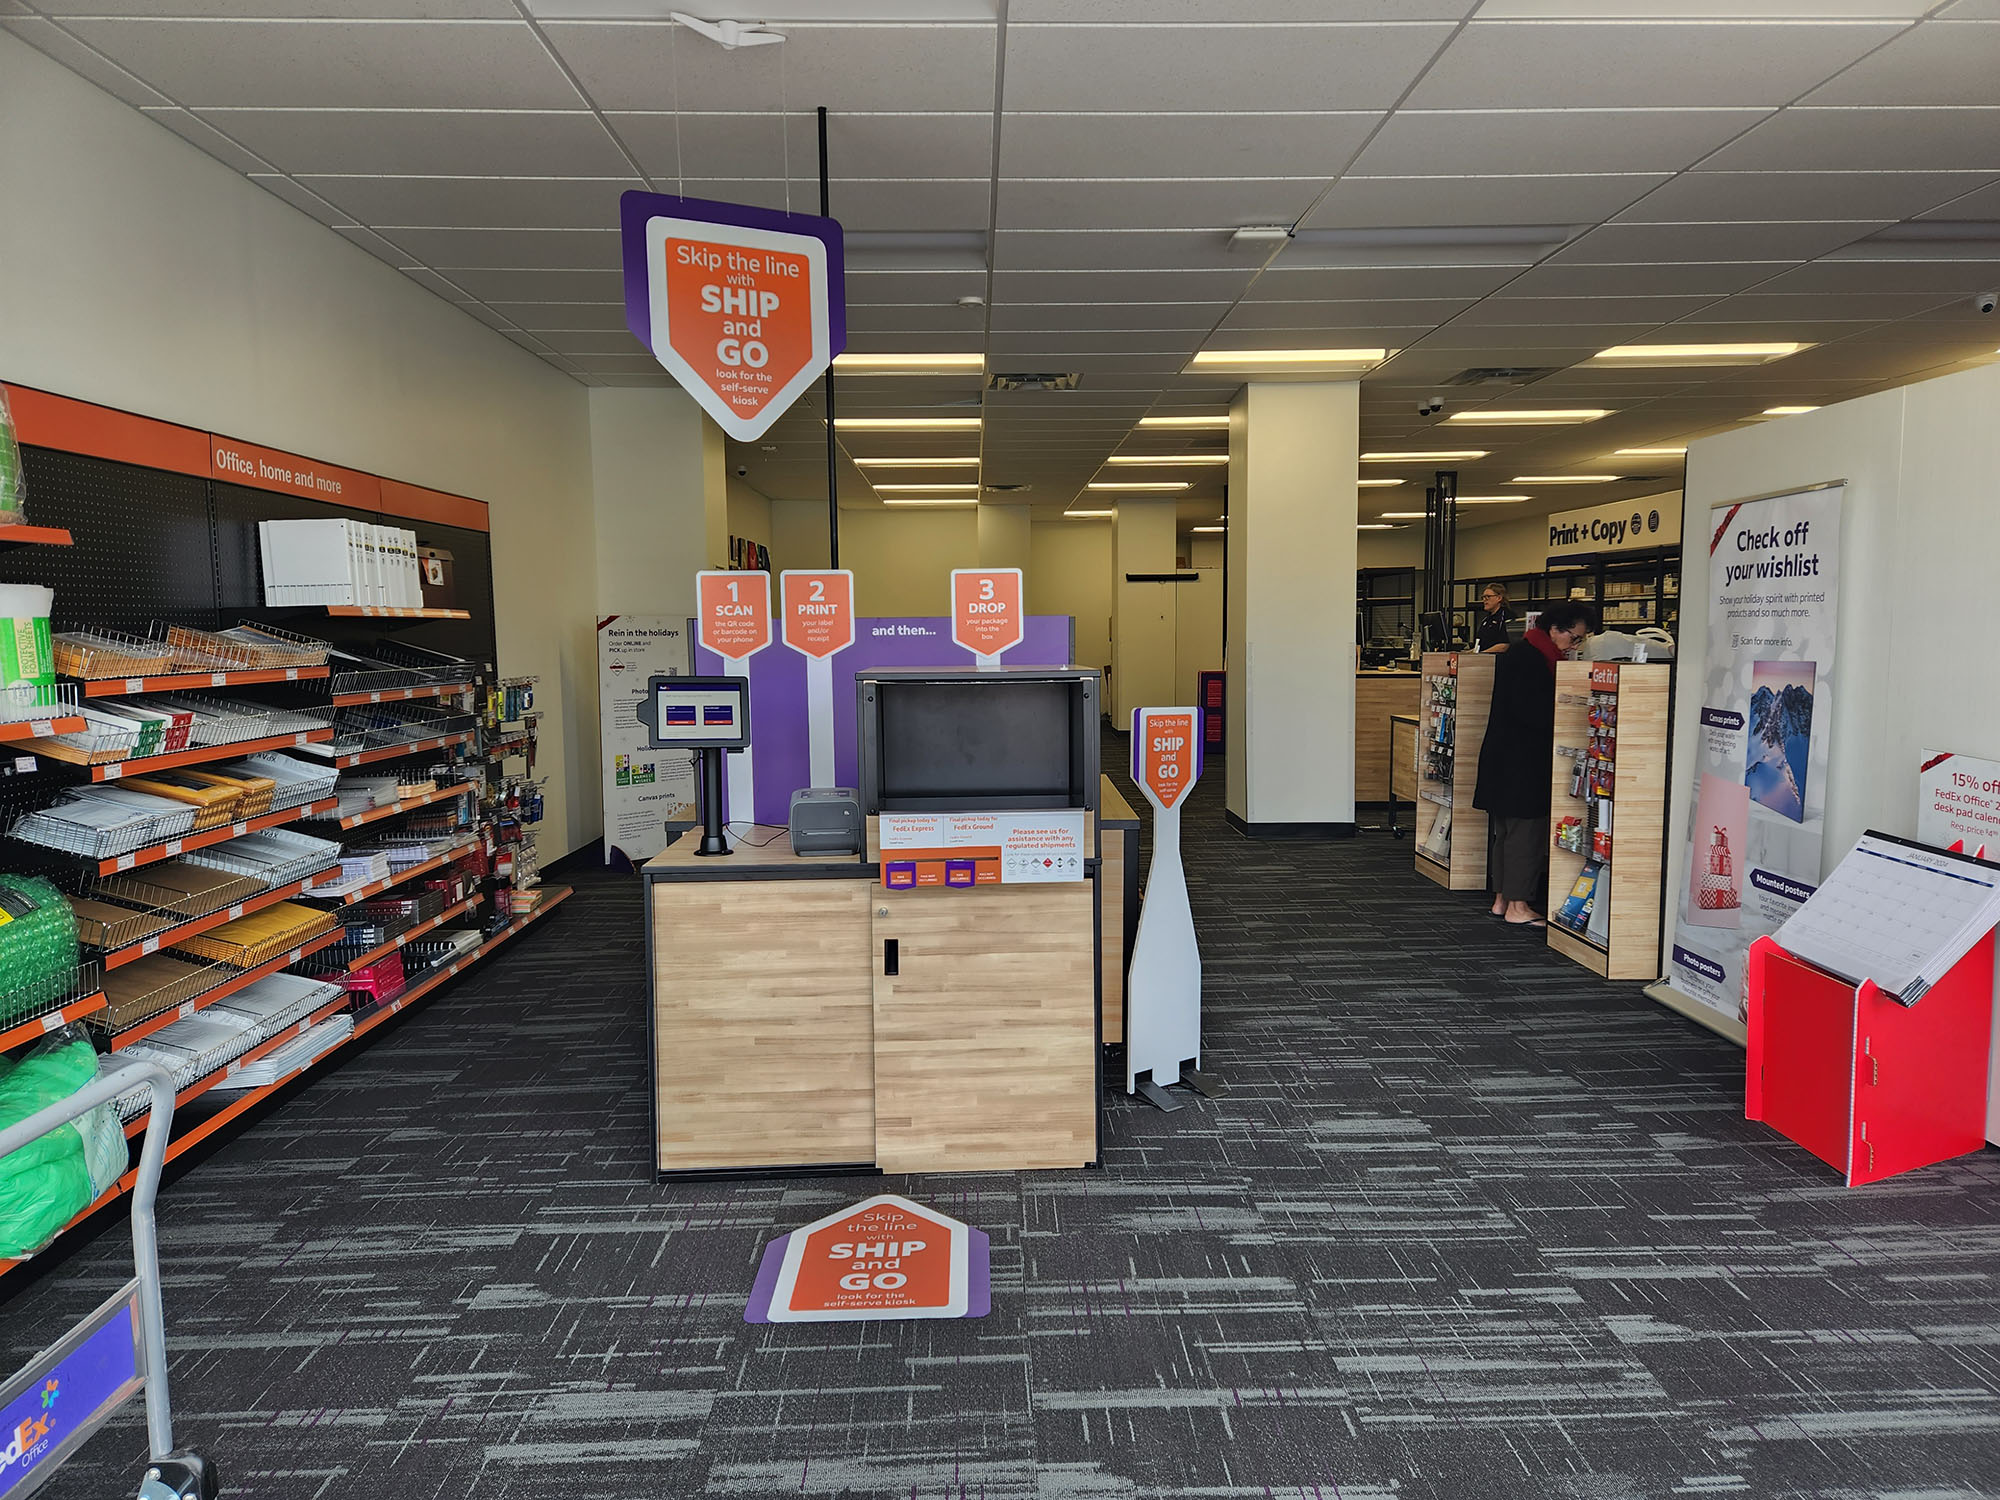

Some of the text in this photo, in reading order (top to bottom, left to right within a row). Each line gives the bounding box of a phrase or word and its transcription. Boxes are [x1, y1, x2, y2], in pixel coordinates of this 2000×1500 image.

[677, 245, 800, 278] Skip the line
[727, 274, 754, 286] with
[701, 284, 780, 318] SHIP
[723, 320, 761, 337] and
[717, 339, 768, 368] GO
[716, 369, 772, 382] look for the
[721, 383, 768, 394] self-serve
[732, 396, 758, 406] kiosk
[216, 449, 342, 494] Office, home and more
[1550, 519, 1627, 546] Print + Copy
[1737, 521, 1809, 551] Check off
[1726, 553, 1819, 587] your wishlist
[727, 582, 738, 602] 1
[809, 581, 825, 601] 2
[979, 579, 994, 600] 3
[1720, 592, 1825, 606] Show your holiday spirit with printed
[716, 605, 753, 616] SCAN
[798, 604, 838, 615] PRINT
[969, 603, 1006, 614] DROP
[1728, 608, 1747, 619] products
[1748, 608, 1760, 617] and
[1771, 608, 1790, 617] much
[1791, 609, 1810, 617] more.
[649, 629, 679, 638] holidays
[872, 625, 936, 636] and then...
[24, 622, 36, 674] FOAM SHEETS
[1741, 636, 1753, 645] Scan
[1754, 636, 1763, 645] for
[1781, 637, 1792, 646] info.
[17, 630, 28, 674] PROTECTIVE
[1593, 668, 1606, 682] Get
[1607, 669, 1612, 683] it
[1150, 720, 1164, 728] Skip
[1723, 716, 1740, 726] prints
[1153, 737, 1184, 751] SHIP
[1161, 753, 1176, 761] and
[1158, 764, 1179, 778] GO
[1952, 773, 1979, 789] 15%
[638, 794, 658, 802] Canvas
[1936, 789, 1961, 802] FedEx
[1934, 802, 2000, 824] desk pad calen
[1951, 821, 1966, 832] Reg.
[1967, 826, 1984, 835] price
[1907, 852, 1948, 867] JANUARY 2024
[1757, 874, 1810, 898] Mounted posters
[1684, 954, 1699, 967] Photo
[1700, 963, 1720, 977] posters
[864, 1213, 903, 1222] Skip
[885, 1222, 917, 1231] line
[828, 1240, 926, 1259] SHIP
[851, 1259, 900, 1270] and
[840, 1273, 907, 1290] GO
[22, 1438, 48, 1467] Office
